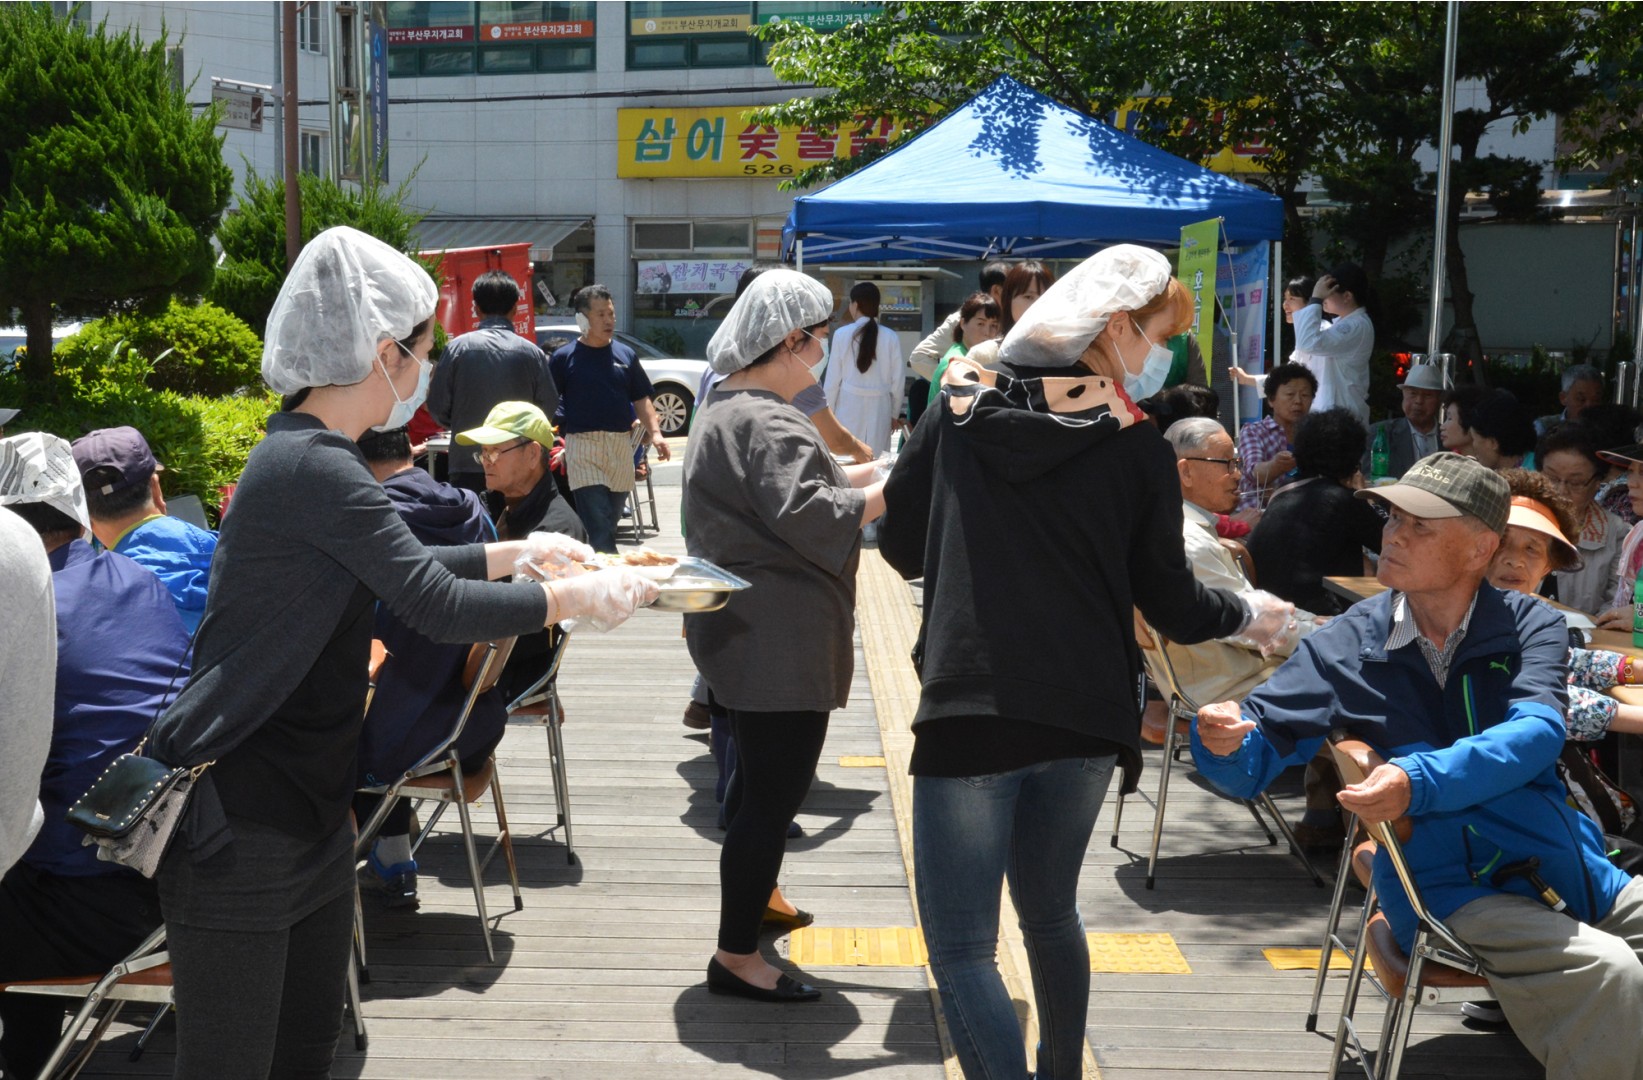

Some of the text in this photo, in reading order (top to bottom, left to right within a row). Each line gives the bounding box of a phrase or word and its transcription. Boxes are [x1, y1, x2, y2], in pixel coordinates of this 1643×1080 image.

[523, 24, 582, 36] 부산무지개교회
[680, 18, 738, 30] 부산무지개교회
[407, 28, 463, 41] 부산무지개교회
[635, 117, 726, 163] 삼어
[743, 164, 794, 175] 526
[671, 261, 746, 281] 잔치국수
[1192, 269, 1204, 338] 호스피
